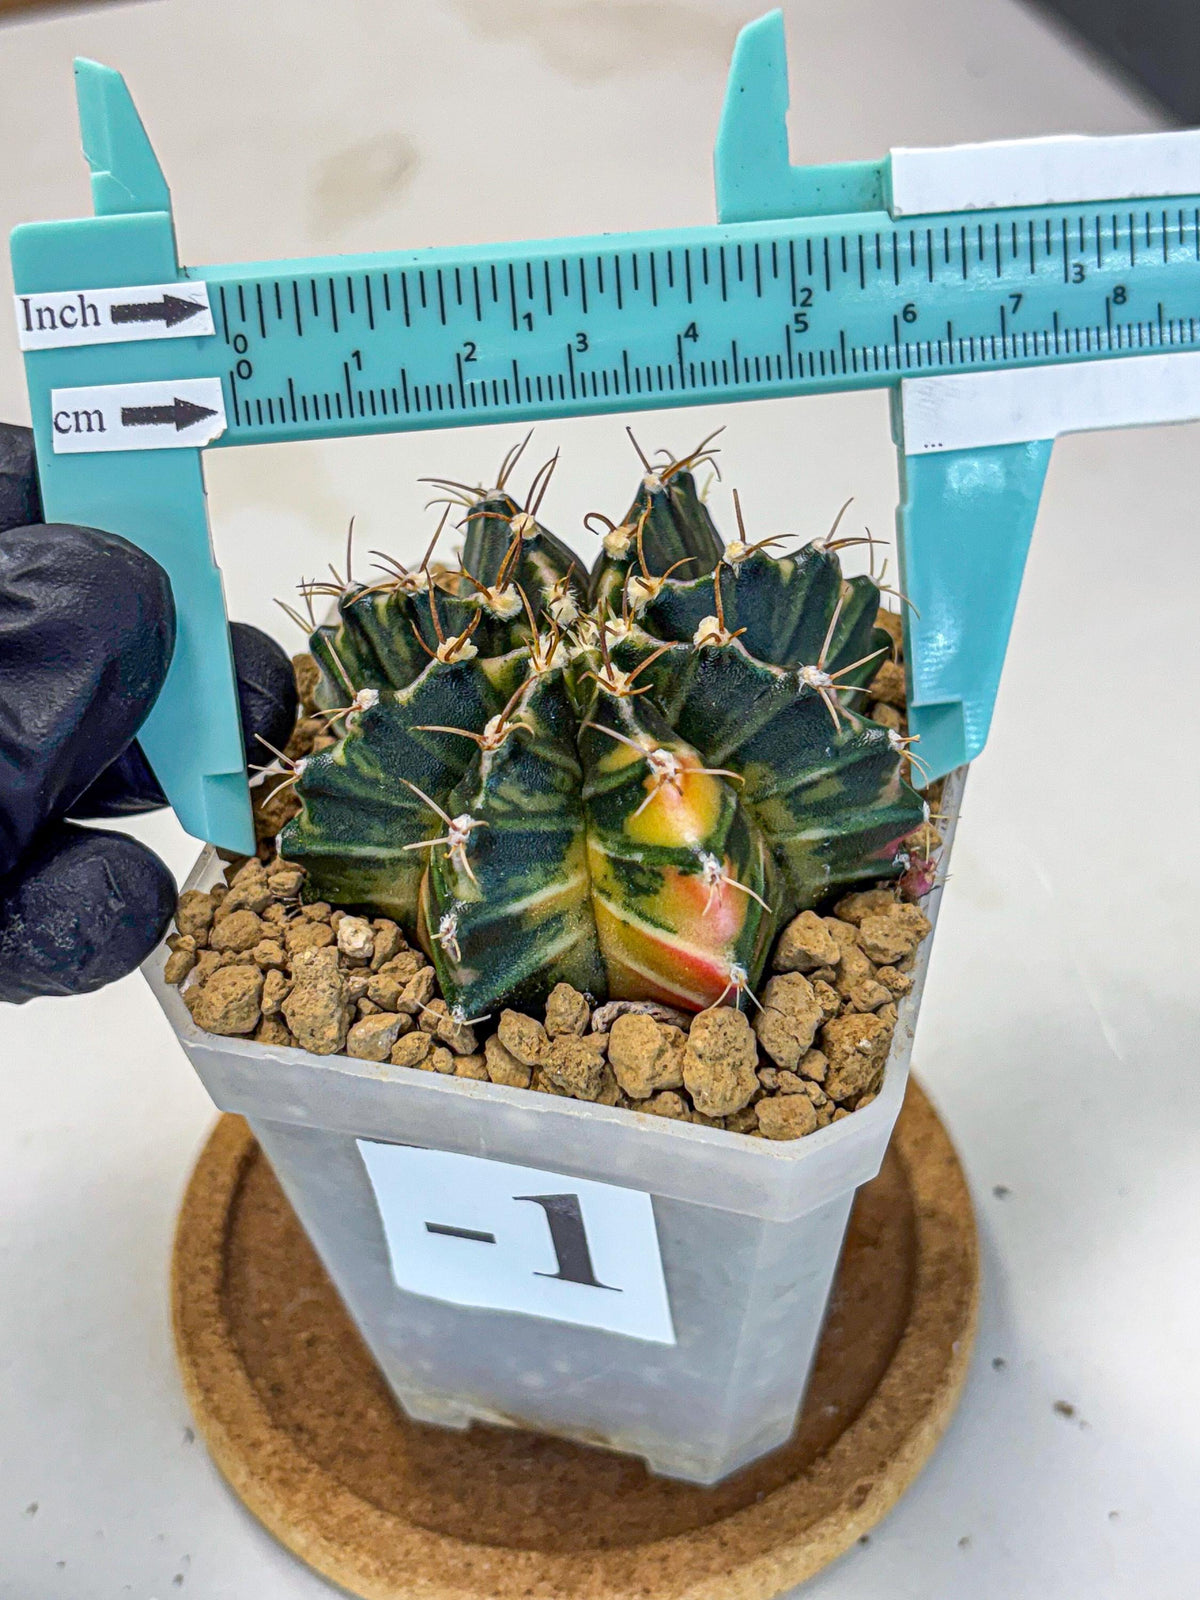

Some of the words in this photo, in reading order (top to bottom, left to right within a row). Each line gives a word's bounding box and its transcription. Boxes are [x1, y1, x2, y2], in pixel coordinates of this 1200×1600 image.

[20, 294, 102, 332] Inch
[233, 333, 249, 354] 0
[522, 312, 534, 332] 1
[799, 287, 813, 308] 2
[1072, 263, 1086, 285] 3
[236, 359, 253, 380] 0
[352, 350, 363, 371] 1
[463, 341, 478, 362] 2
[576, 332, 589, 353] 3
[684, 322, 699, 343] 4
[793, 312, 809, 334] 5
[902, 303, 918, 324] 6
[1008, 293, 1023, 315] 7
[1112, 285, 1128, 306] 8
[53, 408, 107, 434] cm
